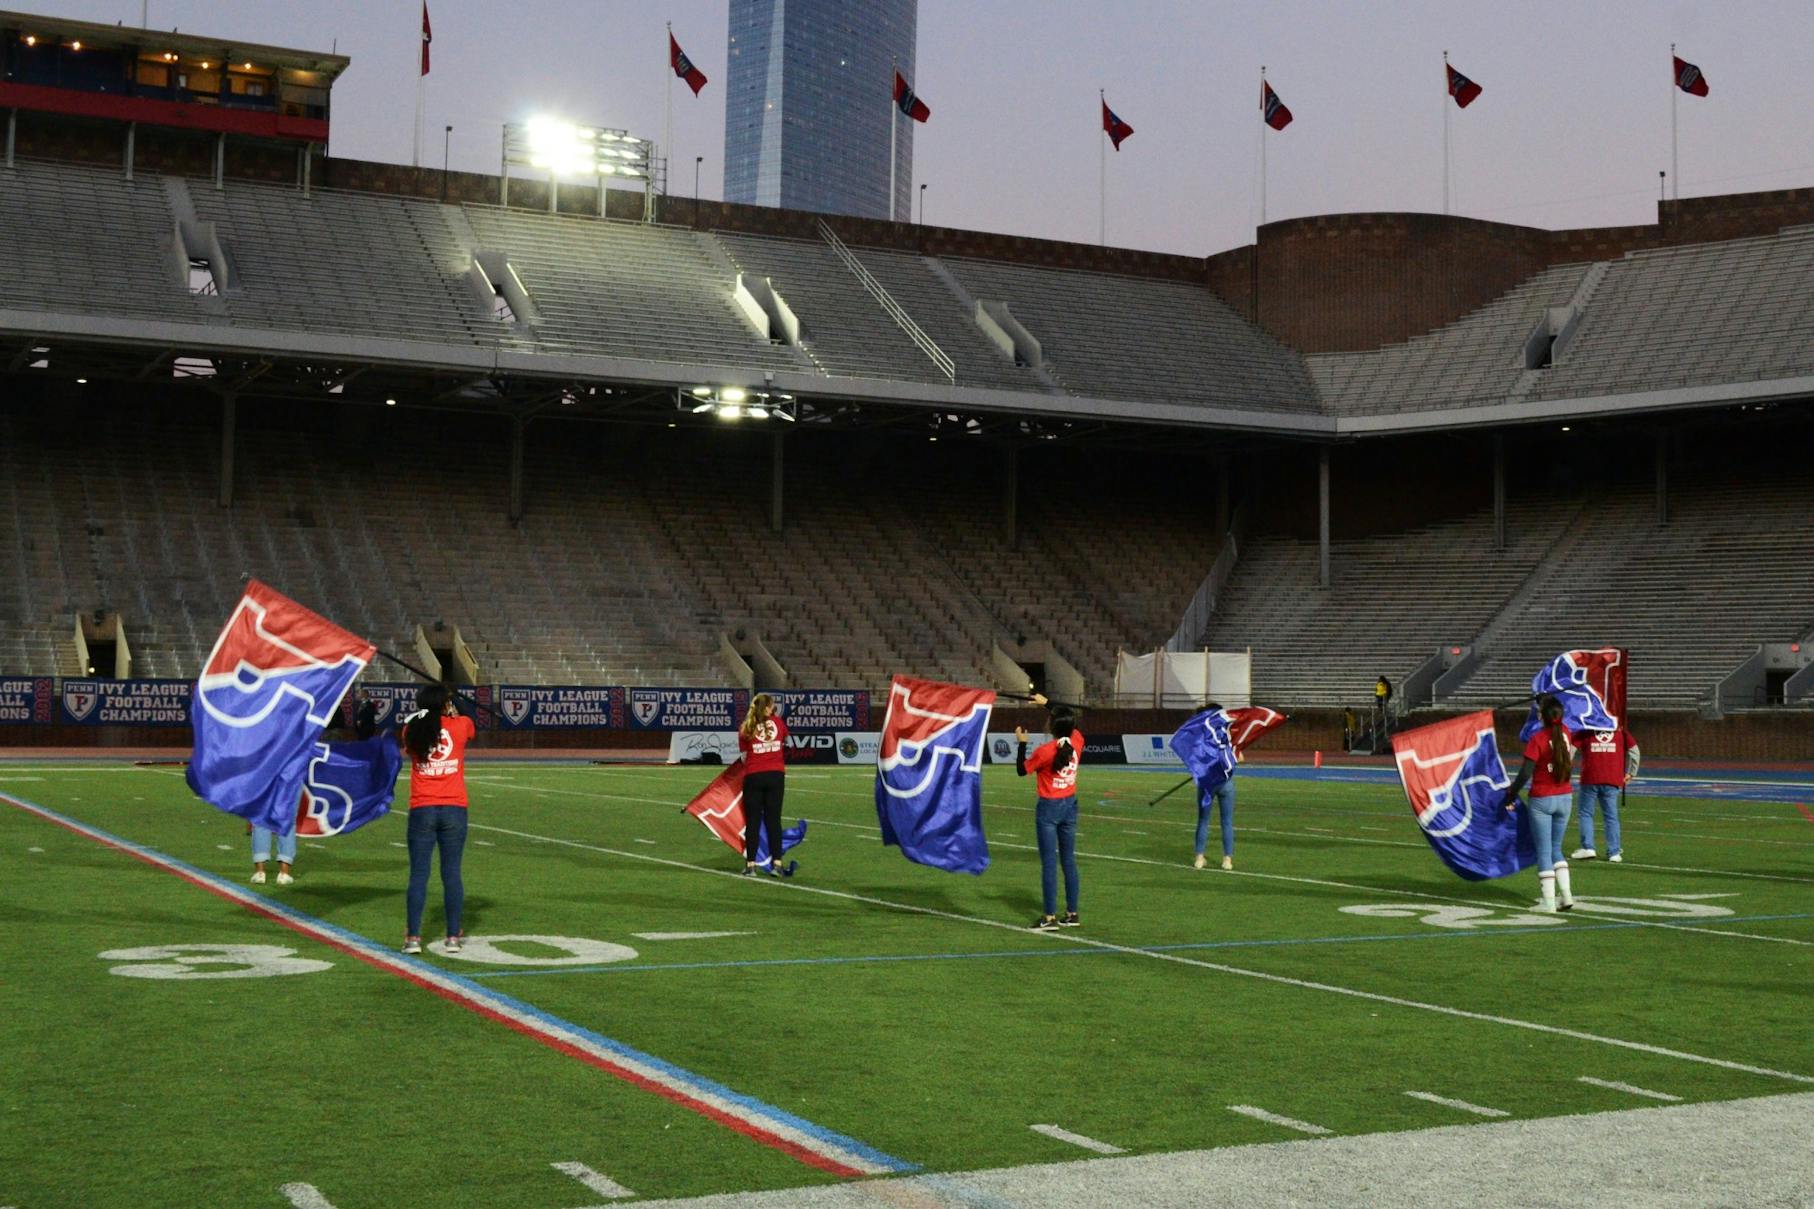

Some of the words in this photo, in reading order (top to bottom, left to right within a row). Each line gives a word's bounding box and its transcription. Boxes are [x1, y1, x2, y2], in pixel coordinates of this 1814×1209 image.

[99, 683, 127, 695] IVY
[131, 684, 189, 696] LEAGUE
[394, 688, 418, 699] IVY
[531, 691, 554, 701] IVY
[559, 690, 609, 701] LEAGUE
[660, 692, 682, 703] IVY
[686, 693, 733, 703] LEAGUE
[785, 694, 805, 704] IVY
[810, 694, 855, 704] LEAGUE
[105, 696, 182, 709] FOOTBALL
[537, 702, 603, 713] FOOTBALL
[511, 702, 523, 717] P
[641, 703, 653, 718] P
[666, 704, 728, 714] FOOTBALL
[100, 709, 187, 722] CHAMPIONS
[533, 714, 607, 725] CHAMPIONS
[661, 715, 732, 726] CHAMPIONS
[786, 717, 853, 728] CHAMPIONS
